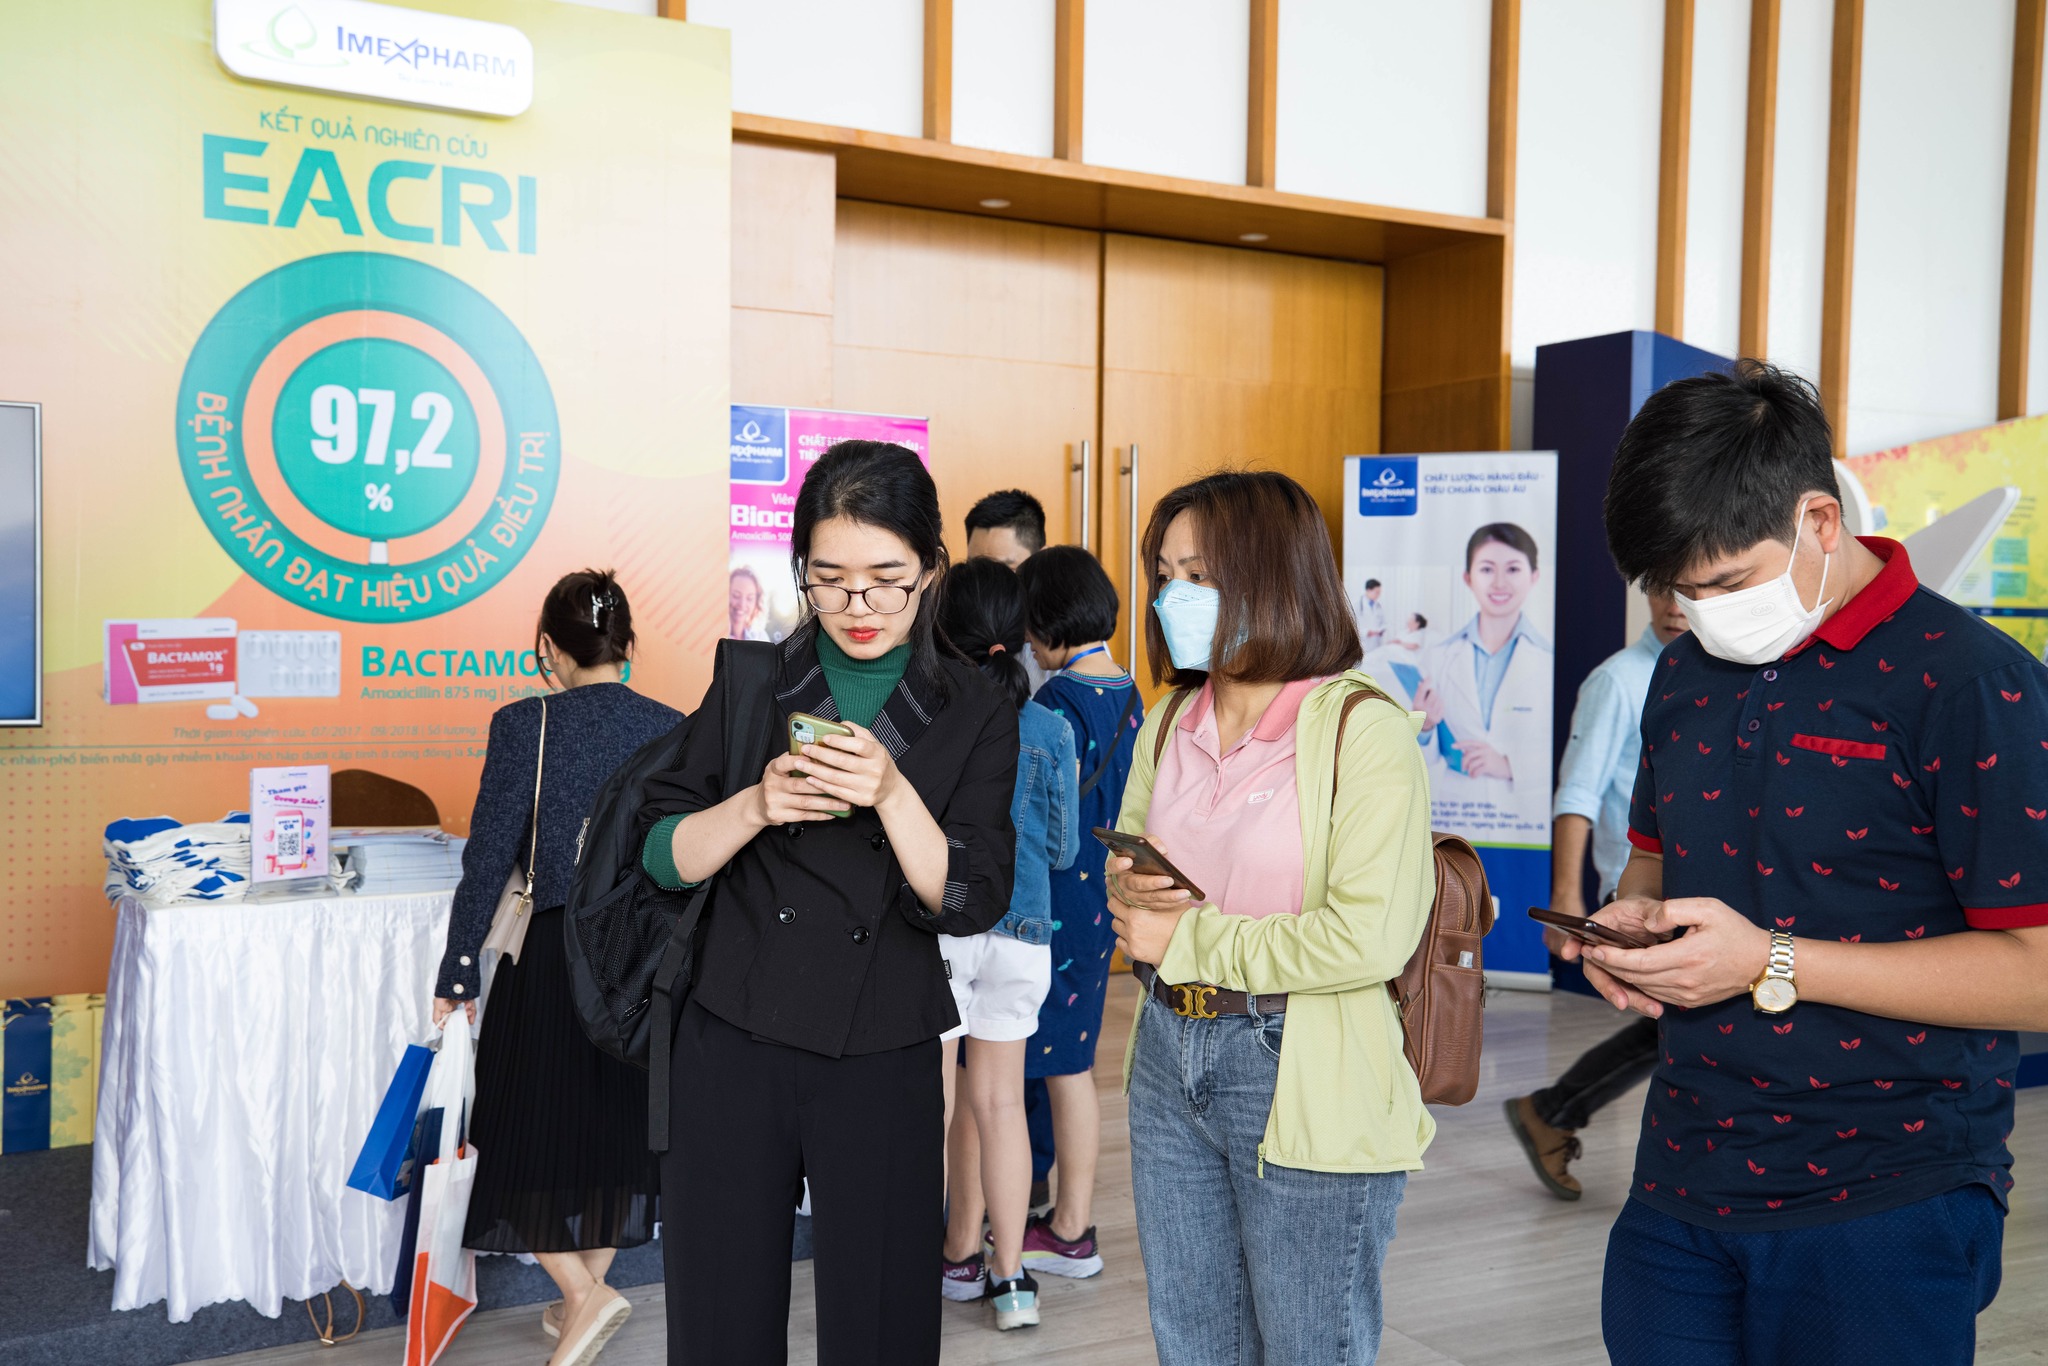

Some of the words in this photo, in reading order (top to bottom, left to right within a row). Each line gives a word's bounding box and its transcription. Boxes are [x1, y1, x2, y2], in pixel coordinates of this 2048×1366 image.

[336, 26, 516, 77] IMEXPHARM
[260, 105, 303, 133] KẾT
[311, 115, 357, 141] QUẢ
[364, 125, 440, 152] NGHIÊN
[447, 133, 488, 159] CỨU
[202, 132, 537, 256] EACRI
[187, 391, 234, 480] BỆNH
[309, 383, 454, 475] 97,2
[798, 433, 826, 447] CHẤT
[517, 431, 550, 474] TRỊ
[799, 448, 823, 462] TIÊ
[364, 482, 393, 512] %
[1424, 484, 1445, 494] TIÊU
[209, 486, 285, 568] NHÂN
[489, 482, 539, 548] ĐIỀU
[283, 556, 354, 602] ĐẠT
[436, 538, 499, 596] QUẢ
[361, 572, 432, 612] HIỆU
[361, 646, 551, 678] BACTAMO
[360, 686, 441, 700] Amoxicillin
[444, 685, 470, 699] 875
[474, 688, 497, 702] mg
[945, 1267, 970, 1278] HOKA
